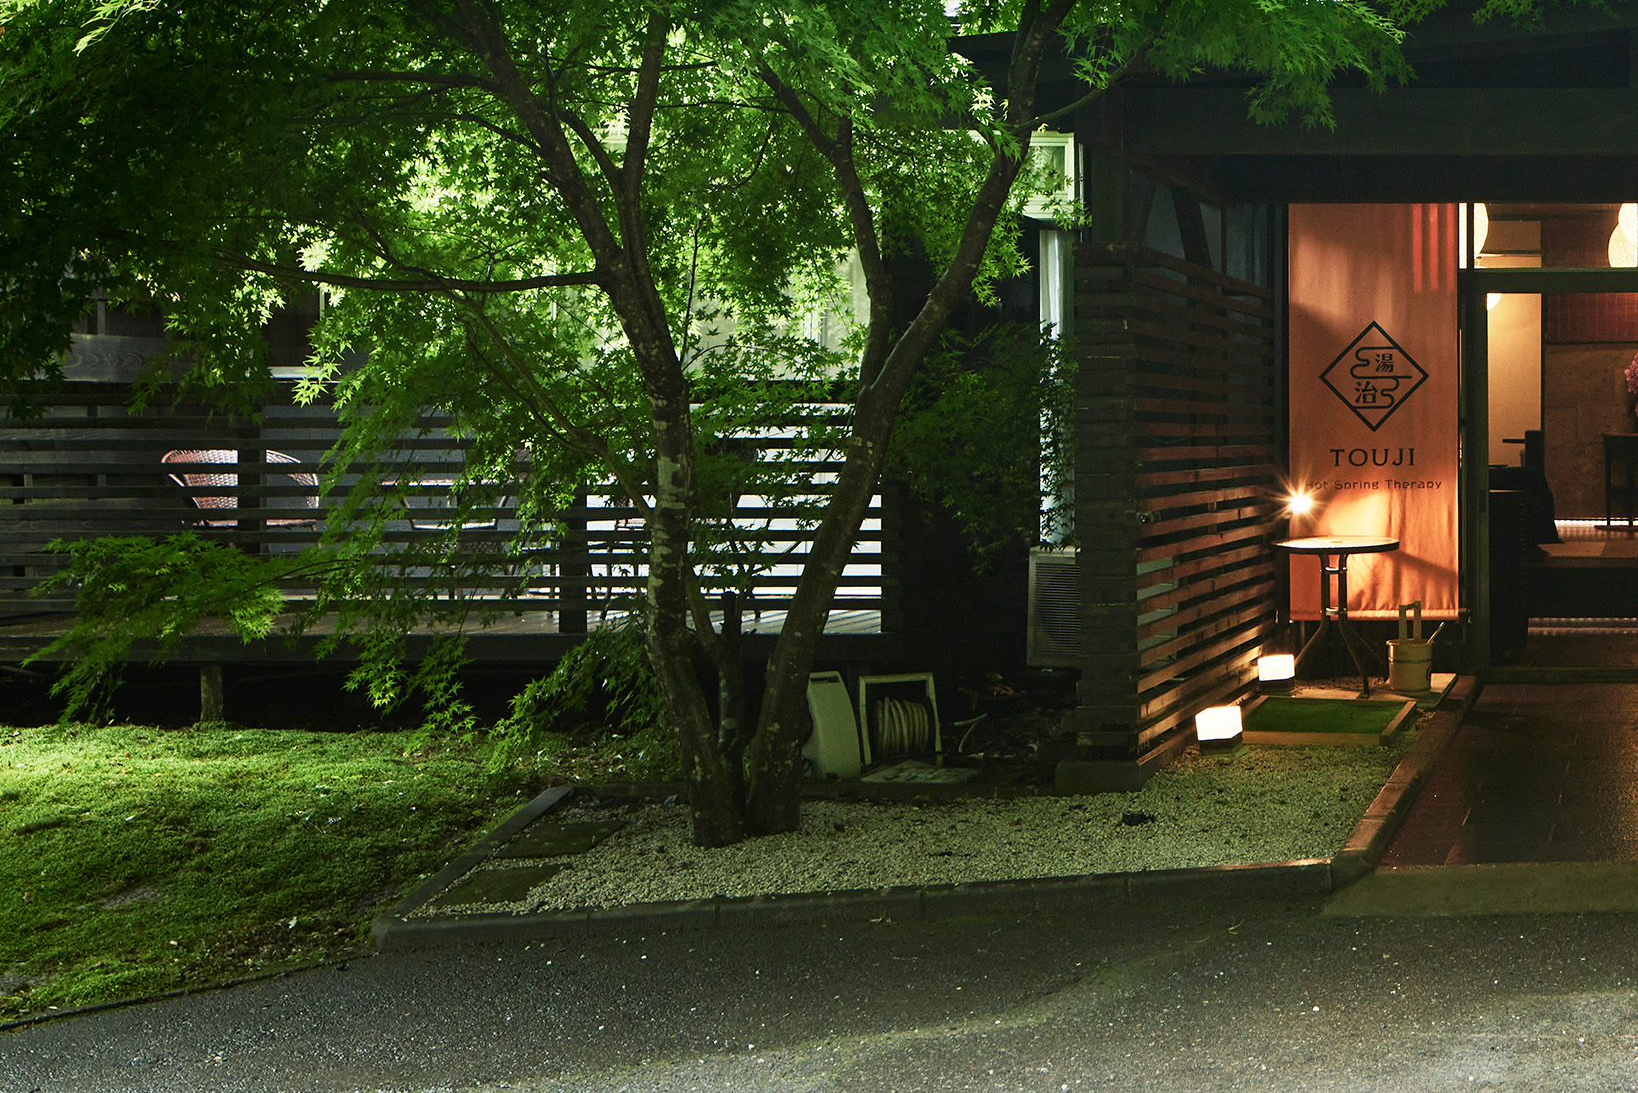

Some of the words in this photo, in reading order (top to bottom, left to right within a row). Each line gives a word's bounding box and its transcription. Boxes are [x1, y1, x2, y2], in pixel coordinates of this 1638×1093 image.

[1330, 448, 1415, 466] TOUJI
[1335, 480, 1379, 490] Spring
[1385, 480, 1442, 490] Therapy
